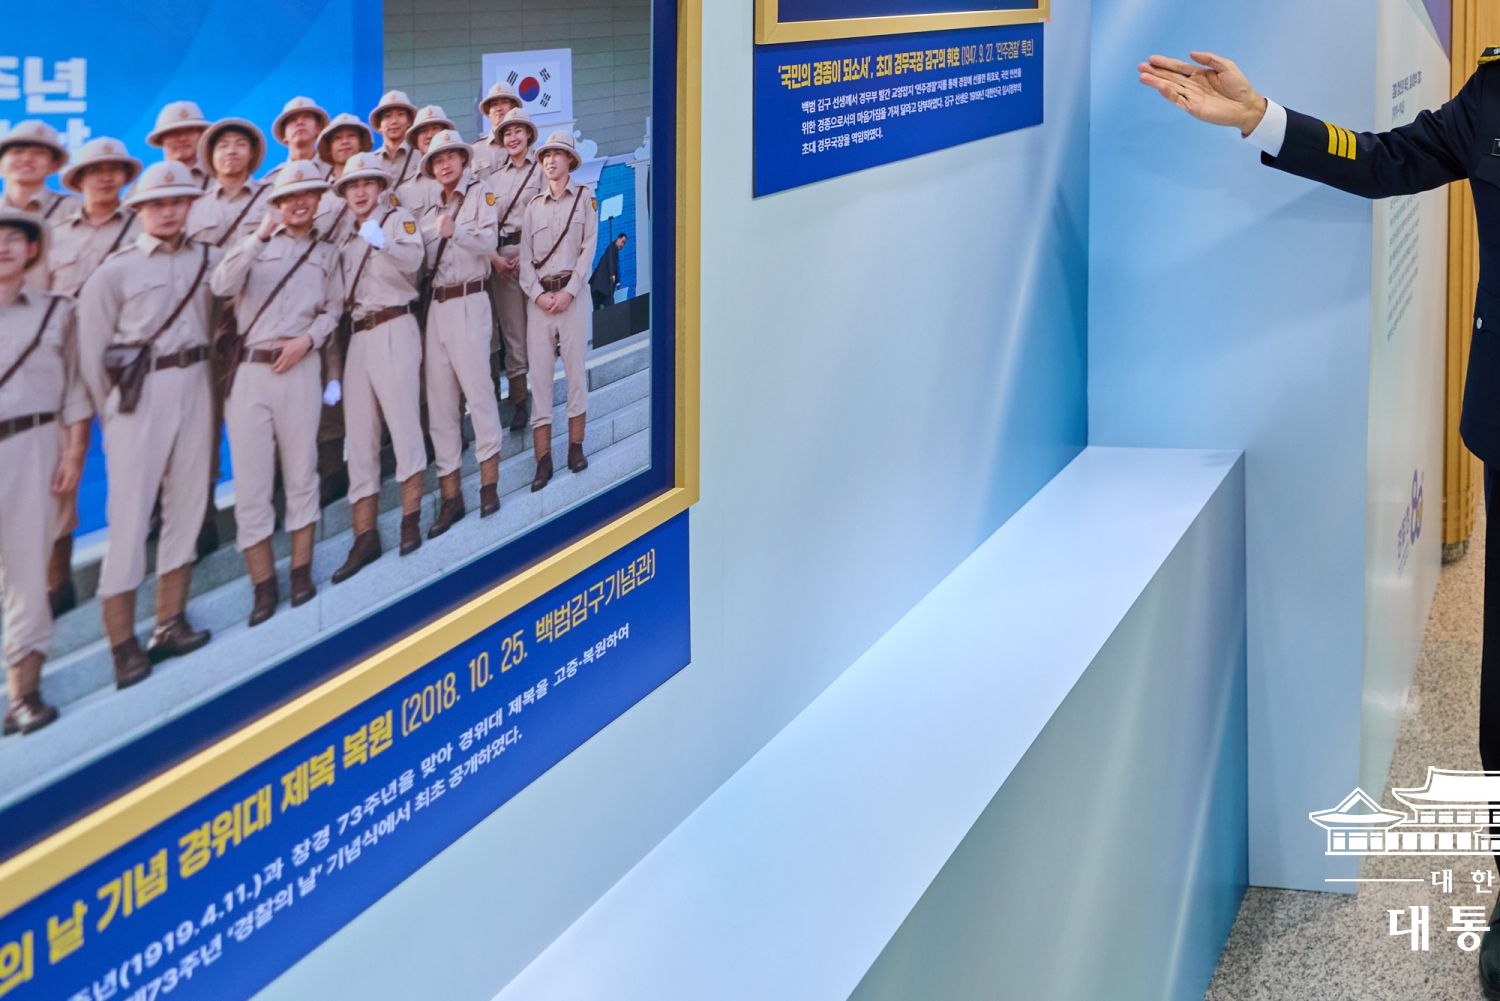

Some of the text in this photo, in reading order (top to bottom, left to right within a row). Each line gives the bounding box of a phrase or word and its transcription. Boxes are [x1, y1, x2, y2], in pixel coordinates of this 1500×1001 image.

[813, 60, 841, 86] 경종이
[876, 54, 892, 77] 초대
[894, 50, 924, 75] 경무국장
[925, 48, 945, 70] 김구의
[947, 47, 960, 67] 휘호
[802, 100, 815, 114] 백범
[818, 98, 831, 112] 김구
[832, 94, 857, 109] 선생께서
[859, 91, 877, 104] 경무부
[879, 89, 890, 101] 발간
[802, 121, 815, 135] 위한
[818, 112, 856, 132] 경종으로서의
[857, 108, 886, 124] 마음가짐을
[888, 104, 899, 117] 가져
[900, 102, 916, 116] 달라고
[945, 95, 954, 107] 김구
[802, 127, 883, 154] 초대 경무국장을 역임하였다.
[47, 899, 88, 964] 날
[97, 848, 168, 931] 기념
[179, 784, 272, 878] 경위대
[280, 745, 335, 814] 제복
[343, 709, 393, 768] 복원
[401, 671, 460, 736] (2018.
[468, 651, 493, 692] 10.
[501, 629, 528, 673] 25.
[535, 548, 656, 643] 백범김구기념관)
[291, 824, 330, 867] 창경
[337, 768, 415, 834] 73주년을
[421, 744, 453, 777] 맞아
[458, 709, 503, 752] 경위대
[508, 677, 548, 716] 제복을
[327, 800, 410, 875] 기념식에서
[415, 780, 446, 812] 최초
[448, 725, 523, 788] 공개하였다.
